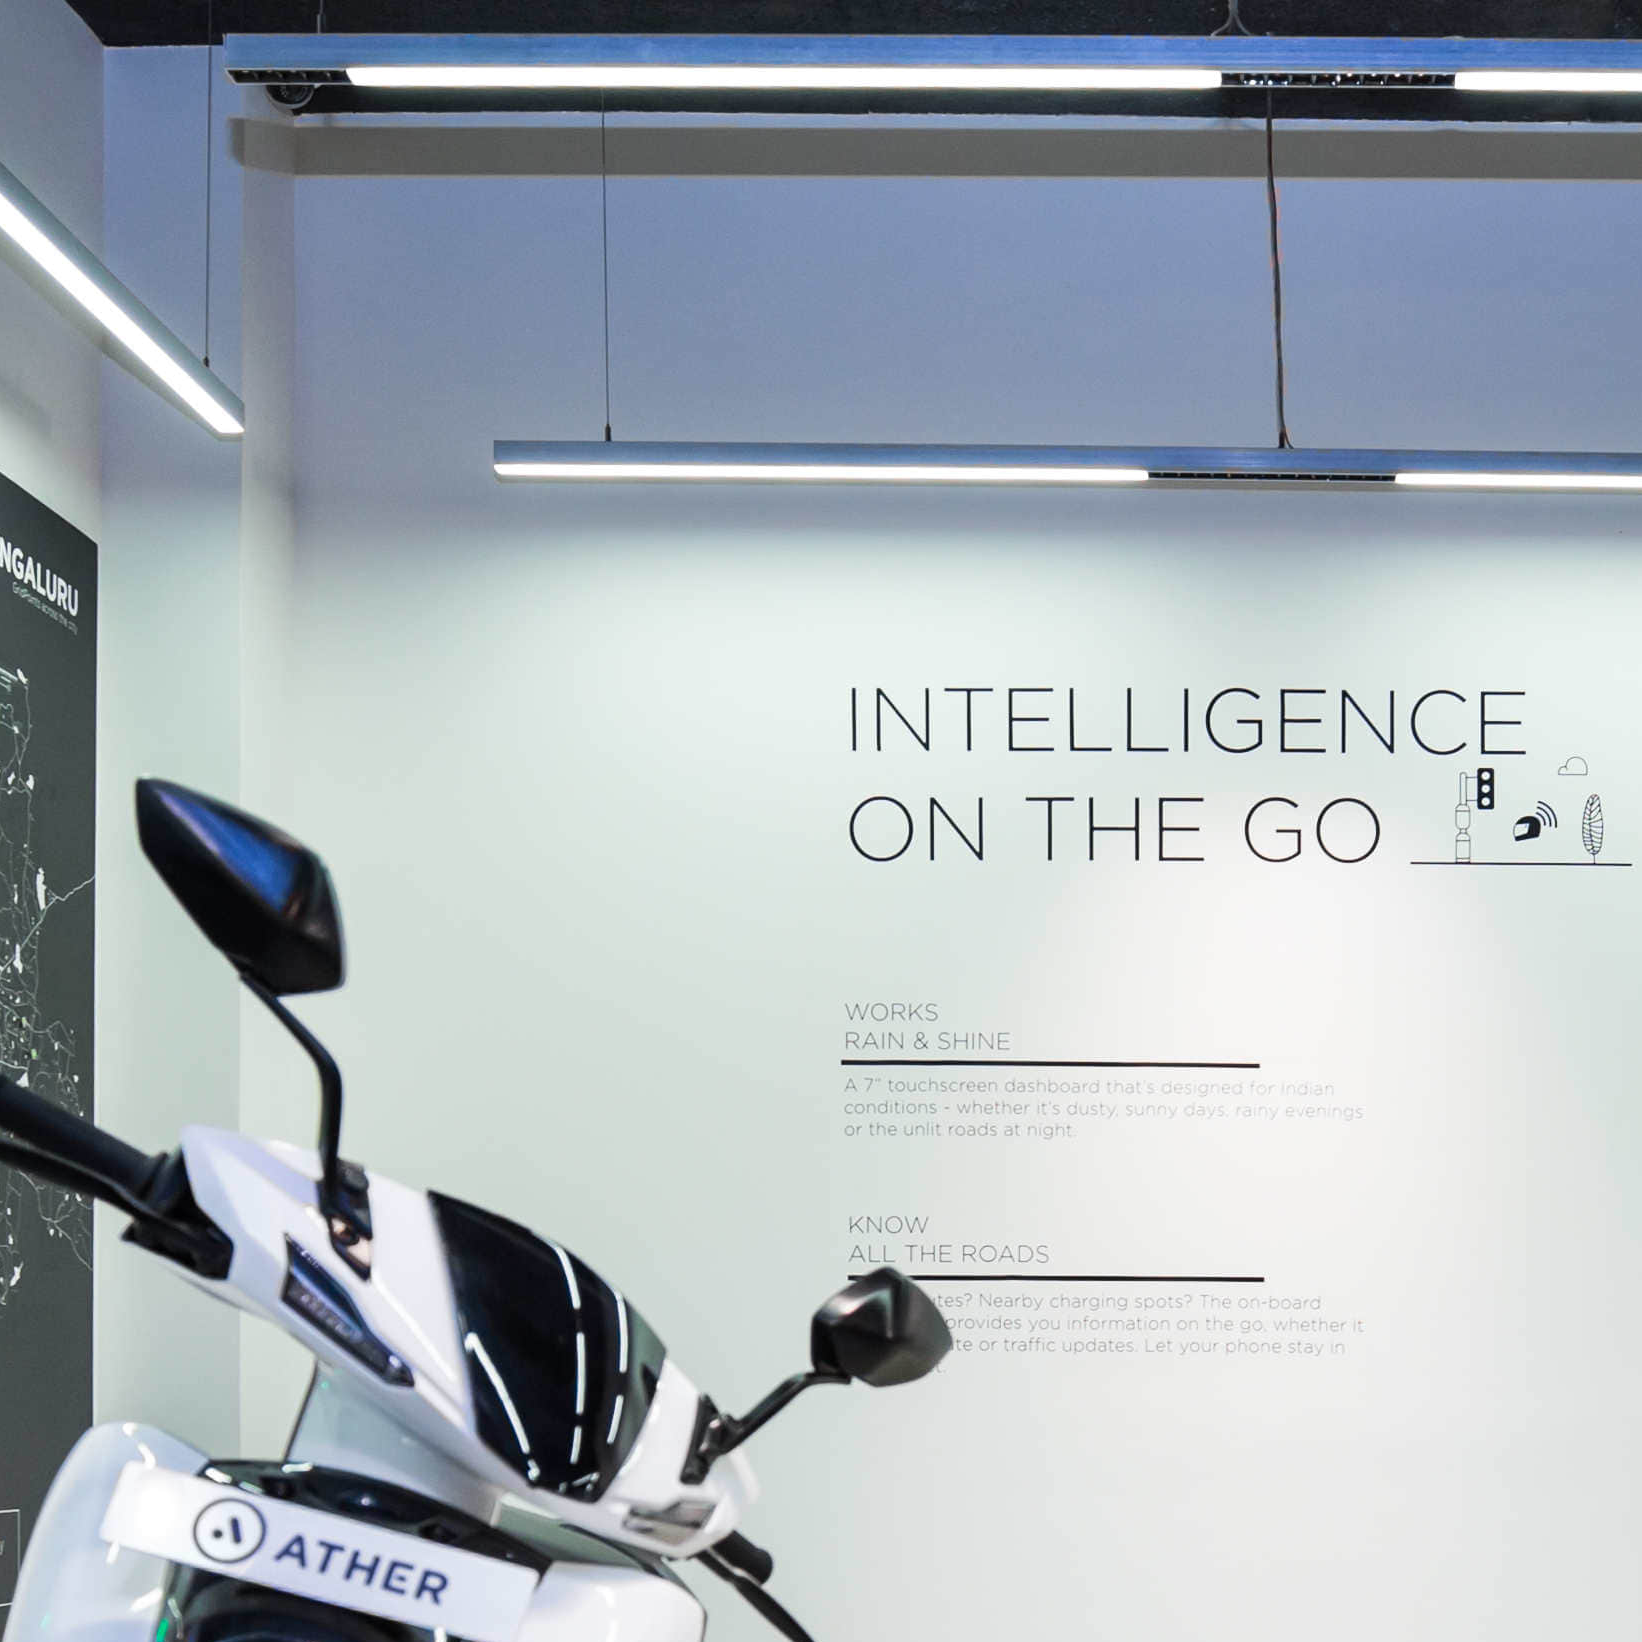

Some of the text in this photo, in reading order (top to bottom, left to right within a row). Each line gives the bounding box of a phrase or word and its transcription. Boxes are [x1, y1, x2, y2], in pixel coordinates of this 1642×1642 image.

[851, 687, 1526, 755] INTELLIGENCE
[849, 796, 1380, 864] ON THE GO
[844, 1003, 939, 1023] WORKS
[845, 1031, 1010, 1051] RAIN & SHINE
[848, 1216, 929, 1234] KNOW
[848, 1244, 1049, 1264] ALL THE ROADS
[274, 1534, 449, 1607] ATHER
